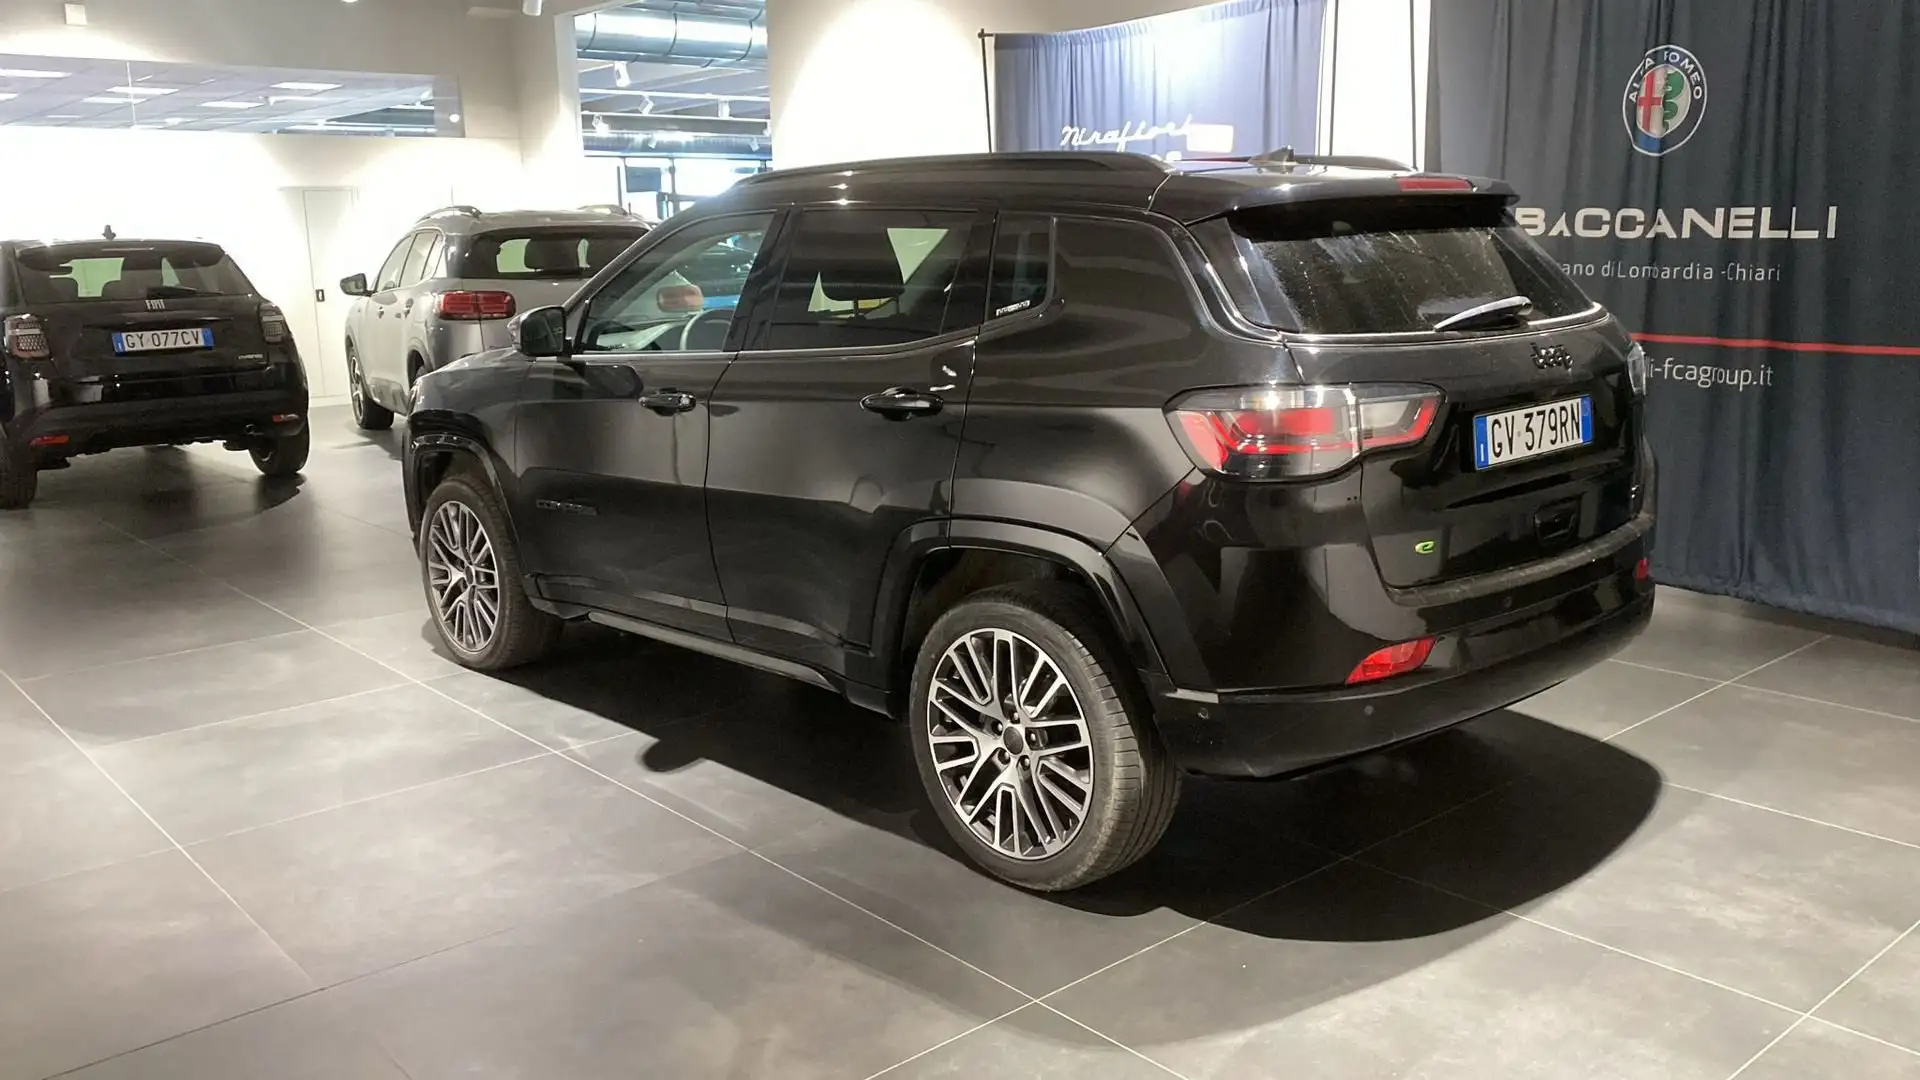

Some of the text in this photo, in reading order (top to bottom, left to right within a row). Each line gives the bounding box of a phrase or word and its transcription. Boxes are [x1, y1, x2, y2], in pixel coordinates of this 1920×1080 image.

[1515, 206, 1837, 239] BACCANELLI
[1557, 262, 1595, 276] ano
[125, 333, 144, 349] GY
[151, 330, 200, 347] 077CV
[1491, 415, 1515, 458] GV
[1523, 402, 1580, 451] 379RN
